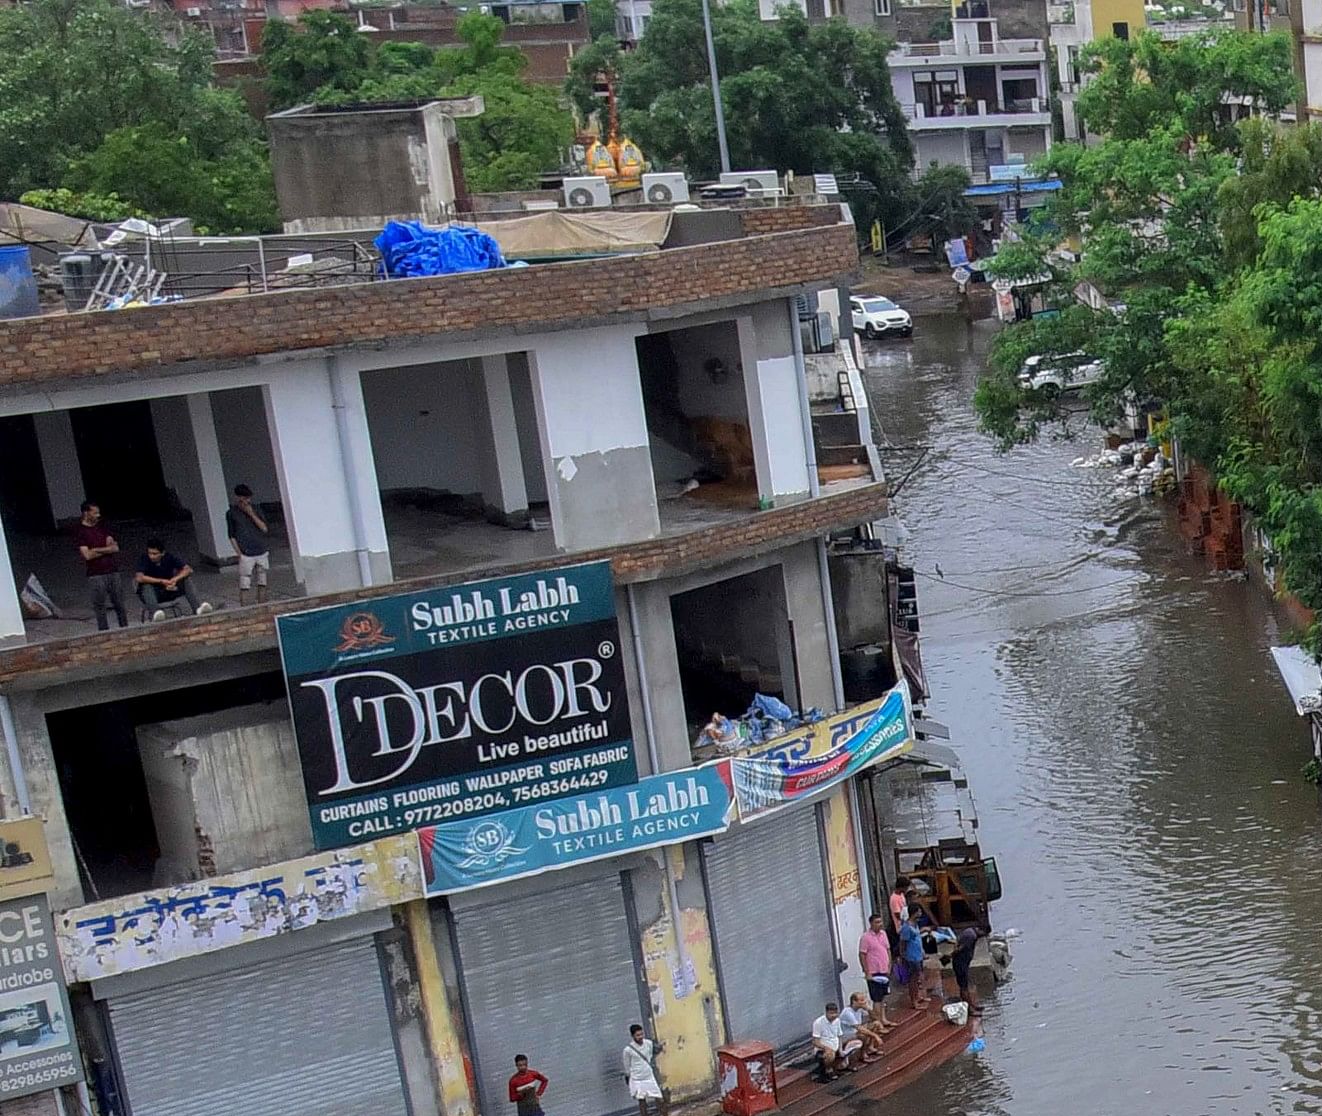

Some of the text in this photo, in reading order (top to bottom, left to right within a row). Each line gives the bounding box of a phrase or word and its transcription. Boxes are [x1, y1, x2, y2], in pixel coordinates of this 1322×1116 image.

[411, 577, 580, 632] Subh Labh
[427, 609, 571, 645] TEXTILE AGENCY
[477, 720, 609, 763] Live beautiful
[320, 746, 629, 823] CURTAINS FLOORING WALLPAPER SOFA FABRIC
[511, 769, 609, 802] 7568364429
[535, 779, 710, 842] Subh Labh
[475, 830, 500, 848] SB
[552, 811, 702, 855] TEXTILE AGENCY
[6, 1051, 73, 1076] Accessories
